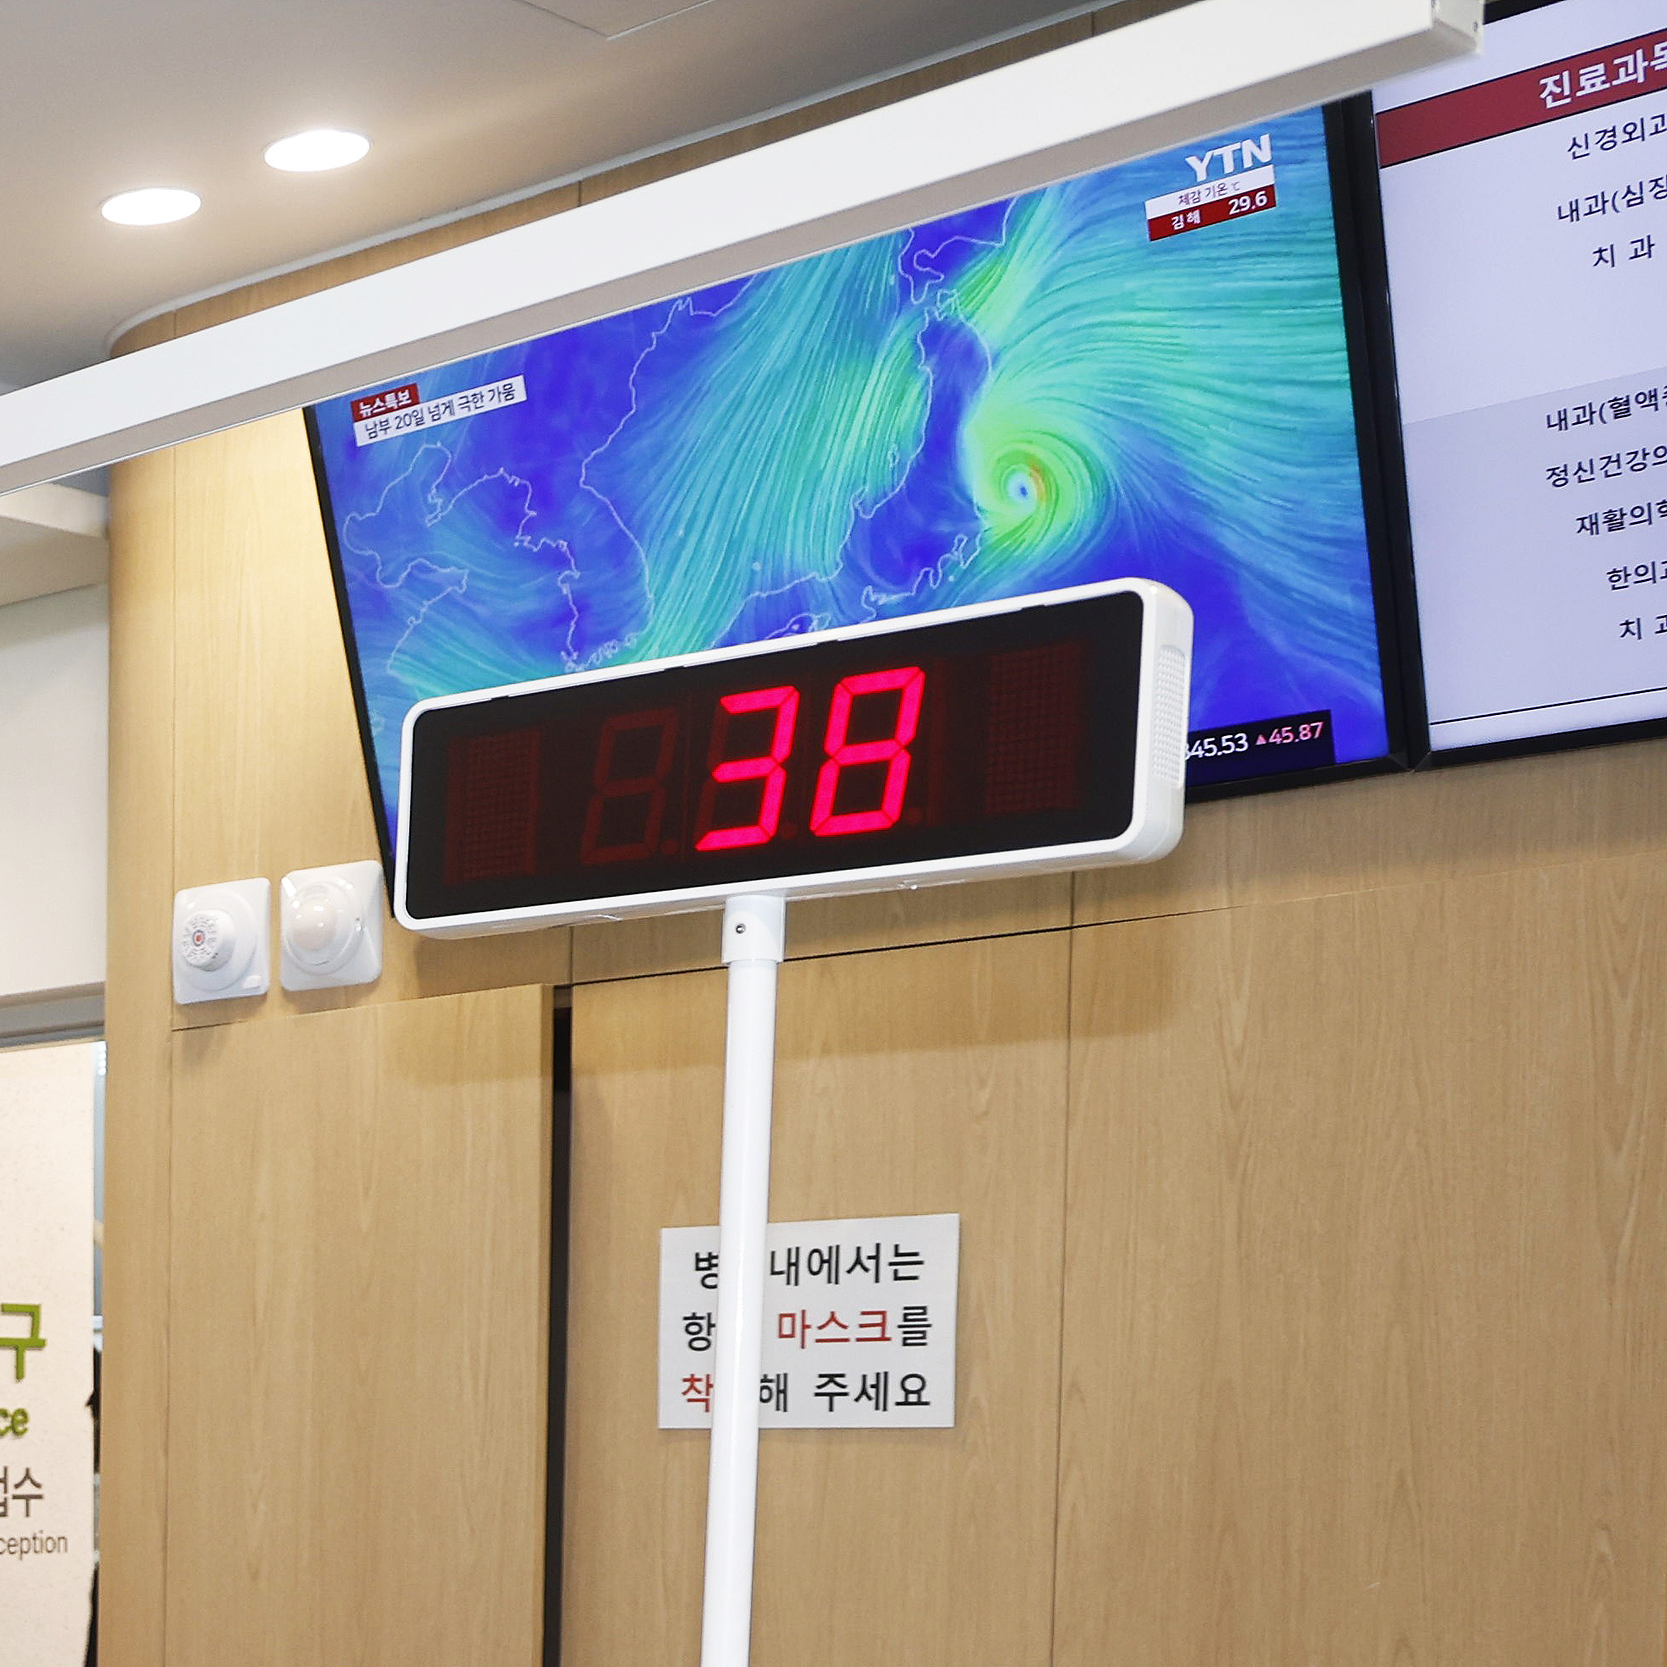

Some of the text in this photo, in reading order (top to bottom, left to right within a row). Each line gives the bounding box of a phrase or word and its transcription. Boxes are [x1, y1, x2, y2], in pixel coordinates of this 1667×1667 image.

[1185, 133, 1272, 182] YTN
[1171, 190, 1268, 230] 김해 29.6
[1205, 182, 1228, 199] 기온
[359, 389, 413, 418] 뉴스특보
[365, 382, 516, 440] 남부 20일 넘게 극한 가뭄
[1546, 384, 1667, 432] 내과(혈액
[695, 665, 925, 852] 38
[777, 1305, 933, 1349] 마스크를
[814, 1371, 931, 1412] 주세요
